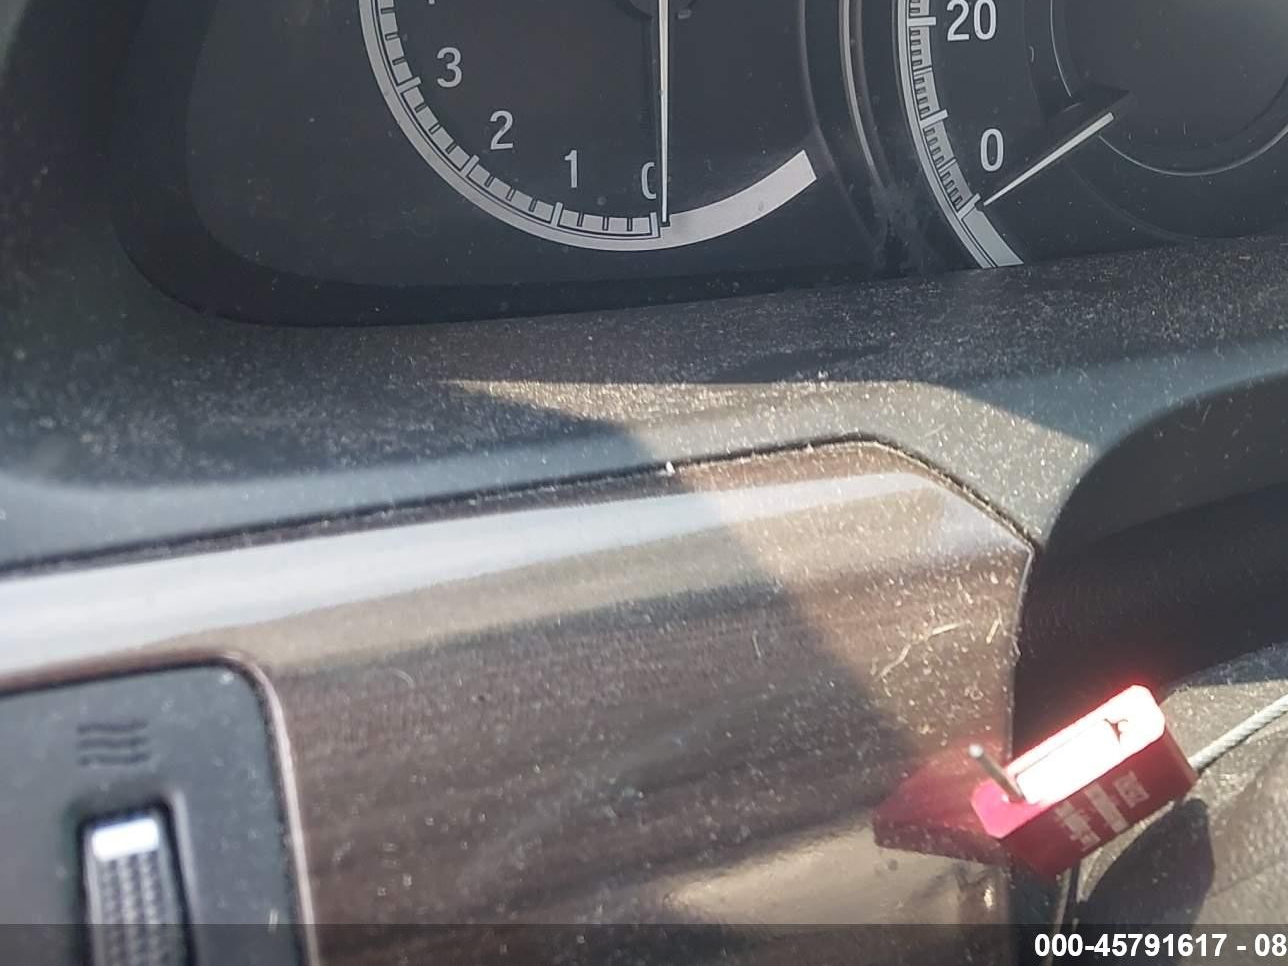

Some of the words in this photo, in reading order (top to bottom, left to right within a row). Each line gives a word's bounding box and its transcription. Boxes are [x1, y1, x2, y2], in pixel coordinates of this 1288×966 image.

[436, 46, 462, 88] 3
[489, 110, 514, 150] 2
[980, 128, 1004, 172] 0
[564, 149, 578, 189] 1
